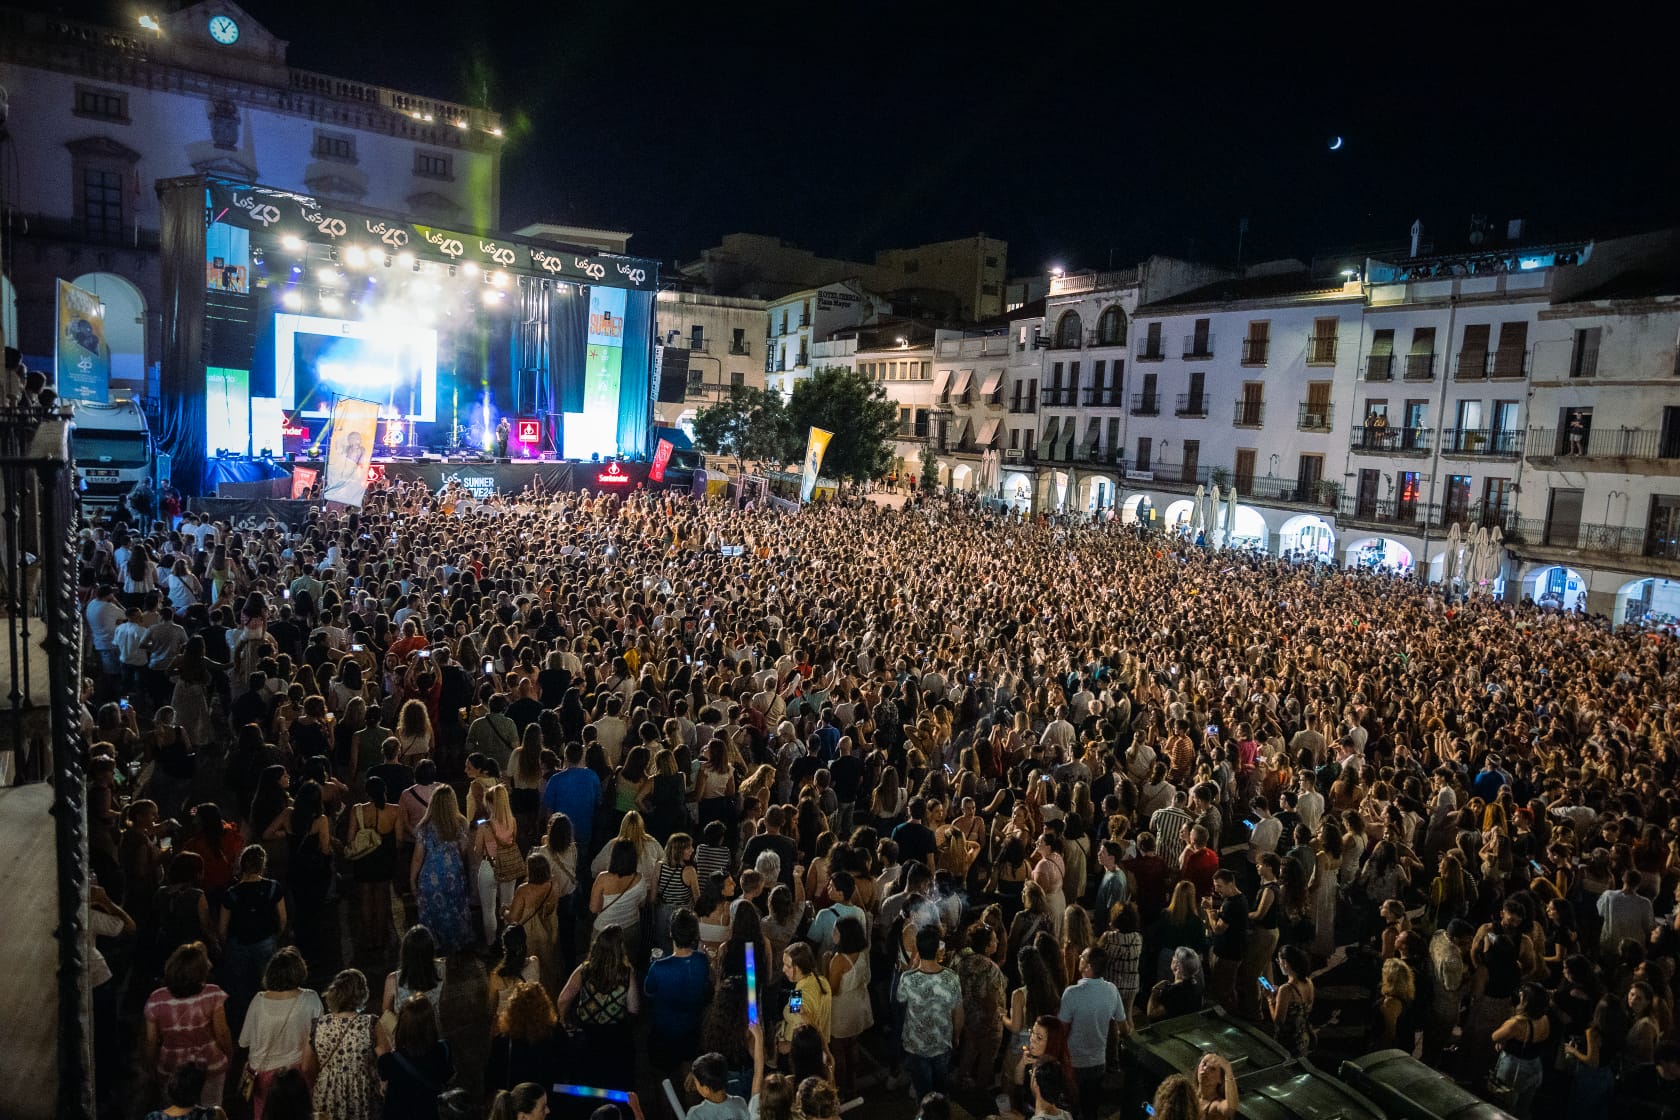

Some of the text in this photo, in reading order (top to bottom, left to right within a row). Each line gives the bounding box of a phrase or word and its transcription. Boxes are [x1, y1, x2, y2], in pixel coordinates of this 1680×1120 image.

[249, 204, 280, 227] 40
[318, 218, 346, 240] 40
[381, 228, 408, 249] 40
[439, 238, 464, 259] 40
[492, 248, 516, 267] 40
[541, 256, 562, 275] 40
[585, 263, 606, 280] 40
[628, 268, 646, 286] 40
[463, 477, 494, 487] SUMMER
